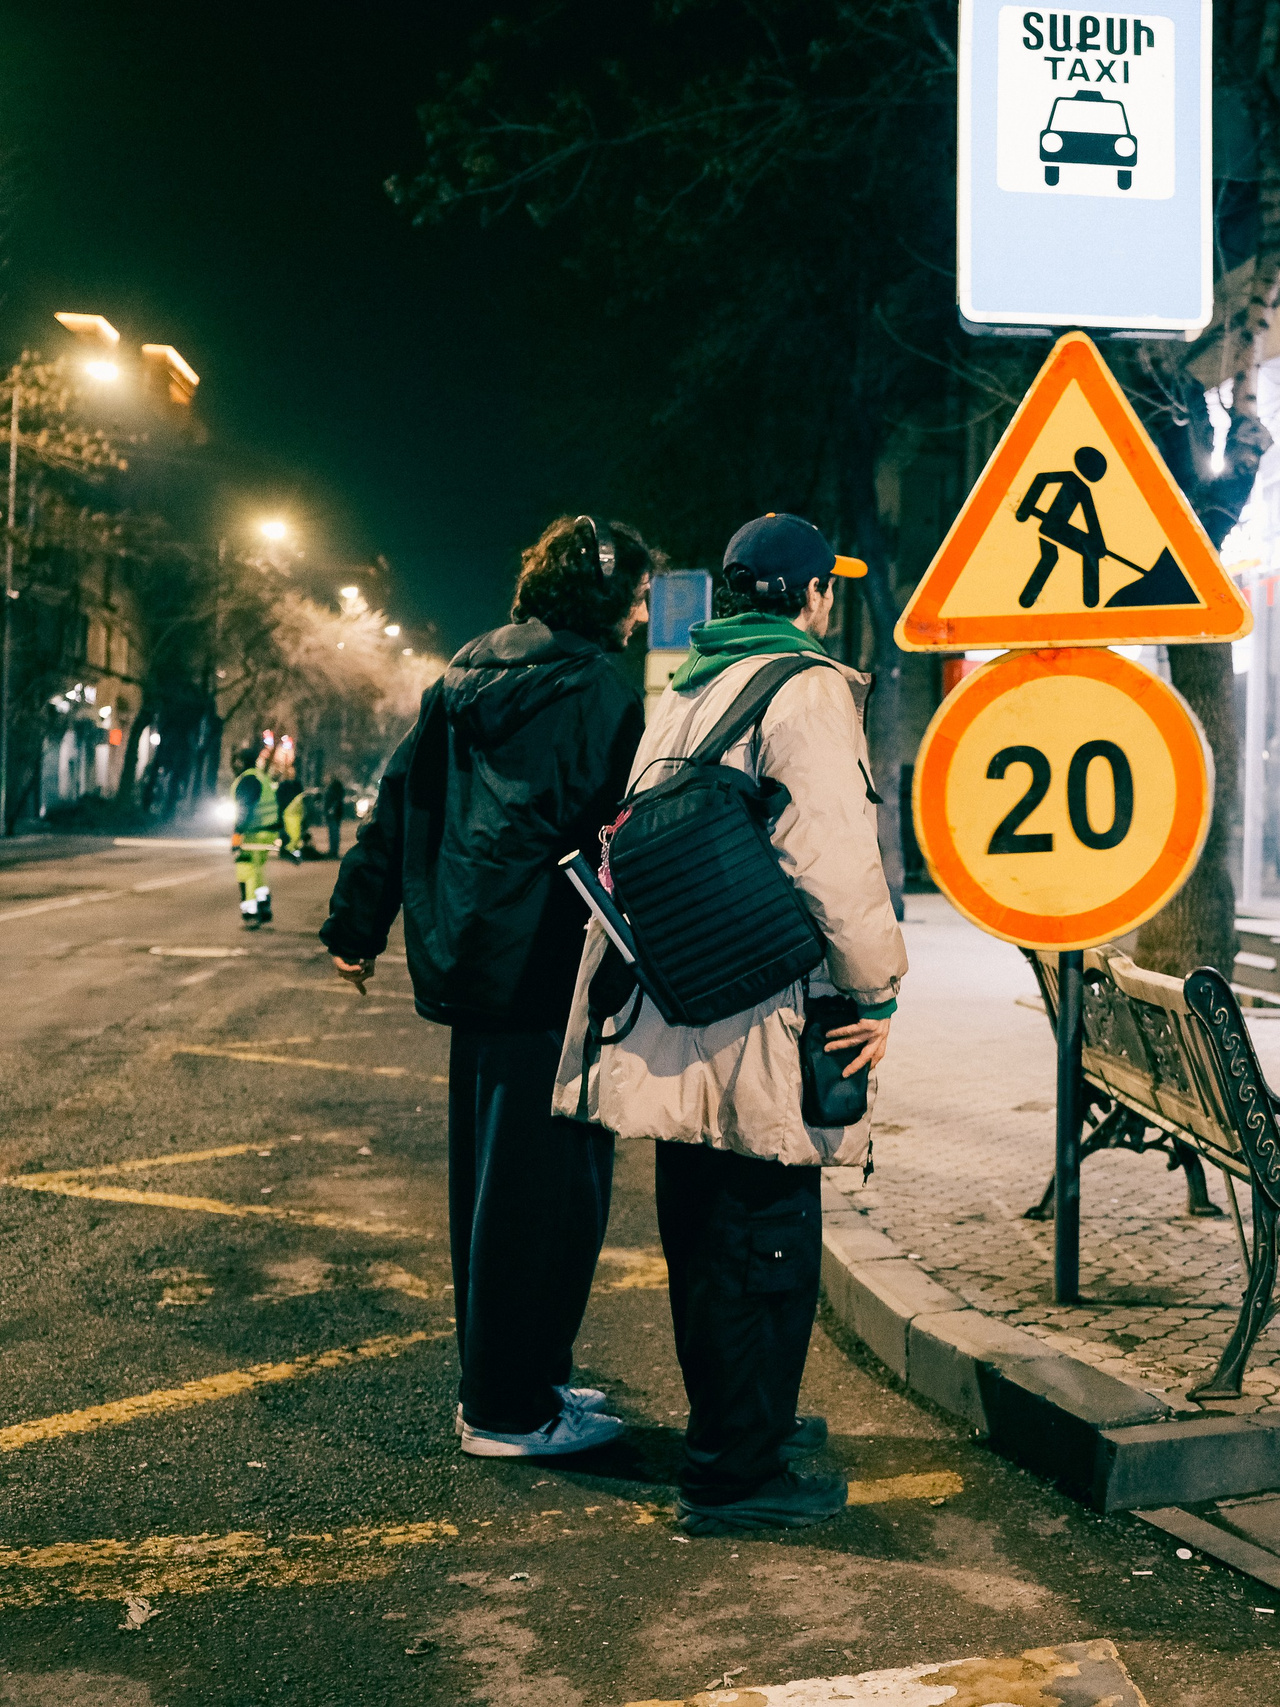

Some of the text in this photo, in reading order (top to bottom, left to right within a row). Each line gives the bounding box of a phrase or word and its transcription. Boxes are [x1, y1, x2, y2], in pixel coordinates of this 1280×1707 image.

[1044, 56, 1130, 84] TAXI
[664, 578, 696, 643] P
[985, 739, 1135, 855] 20
